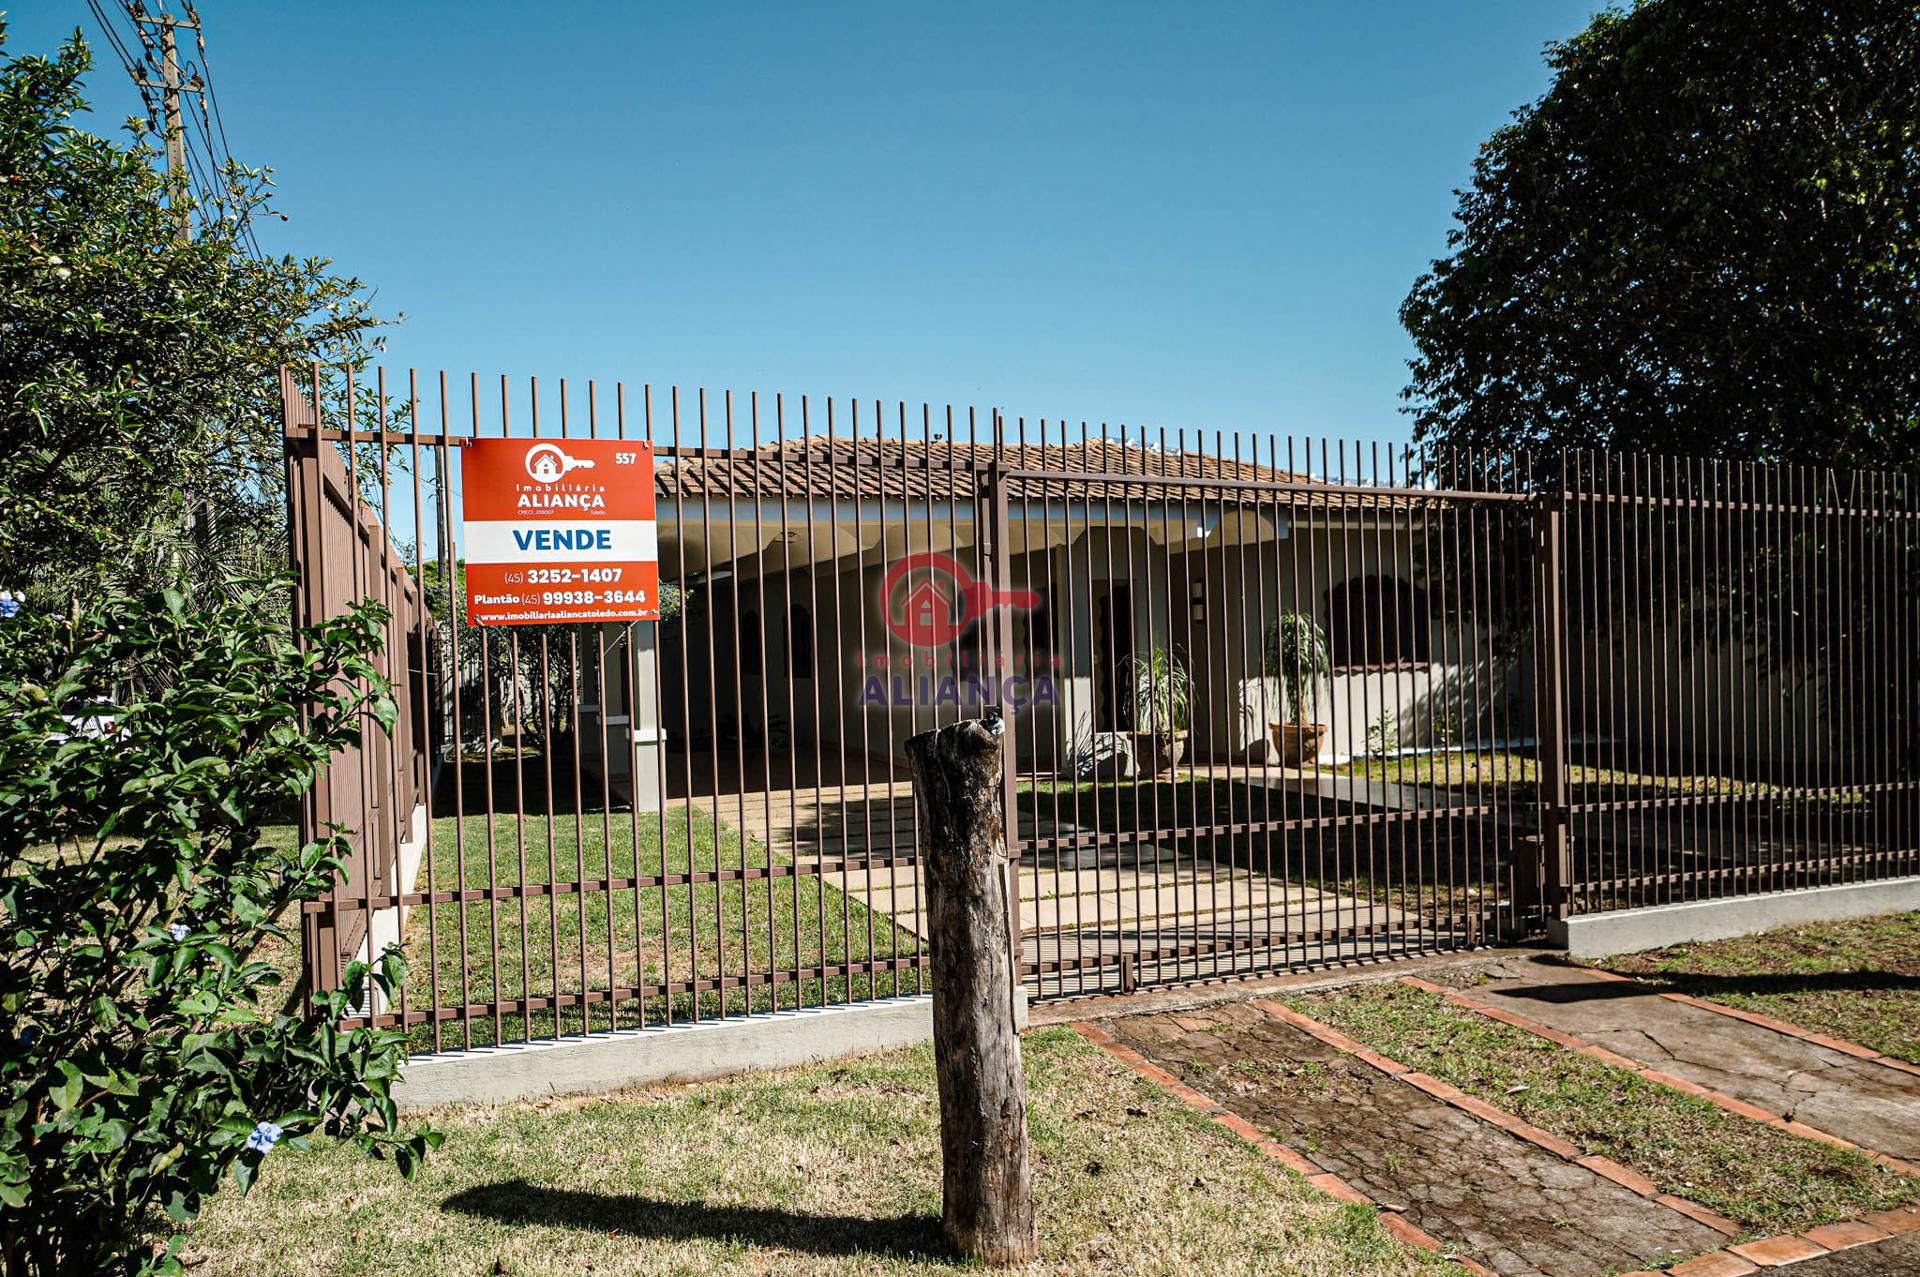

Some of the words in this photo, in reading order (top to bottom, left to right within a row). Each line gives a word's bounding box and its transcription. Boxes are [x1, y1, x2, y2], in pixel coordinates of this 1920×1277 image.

[615, 452, 637, 465] 557
[516, 484, 606, 492] Imobiliária
[517, 494, 606, 511] ALIANÇA
[512, 529, 612, 551] VENDE
[504, 572, 524, 584] (45)
[527, 568, 623, 584] 3252-1407
[474, 594, 520, 605] Plantão
[521, 593, 541, 606] (45)
[543, 590, 646, 605] 99938-3644
[481, 609, 648, 621] www.imobiliariaaliancatoledo.com.br
